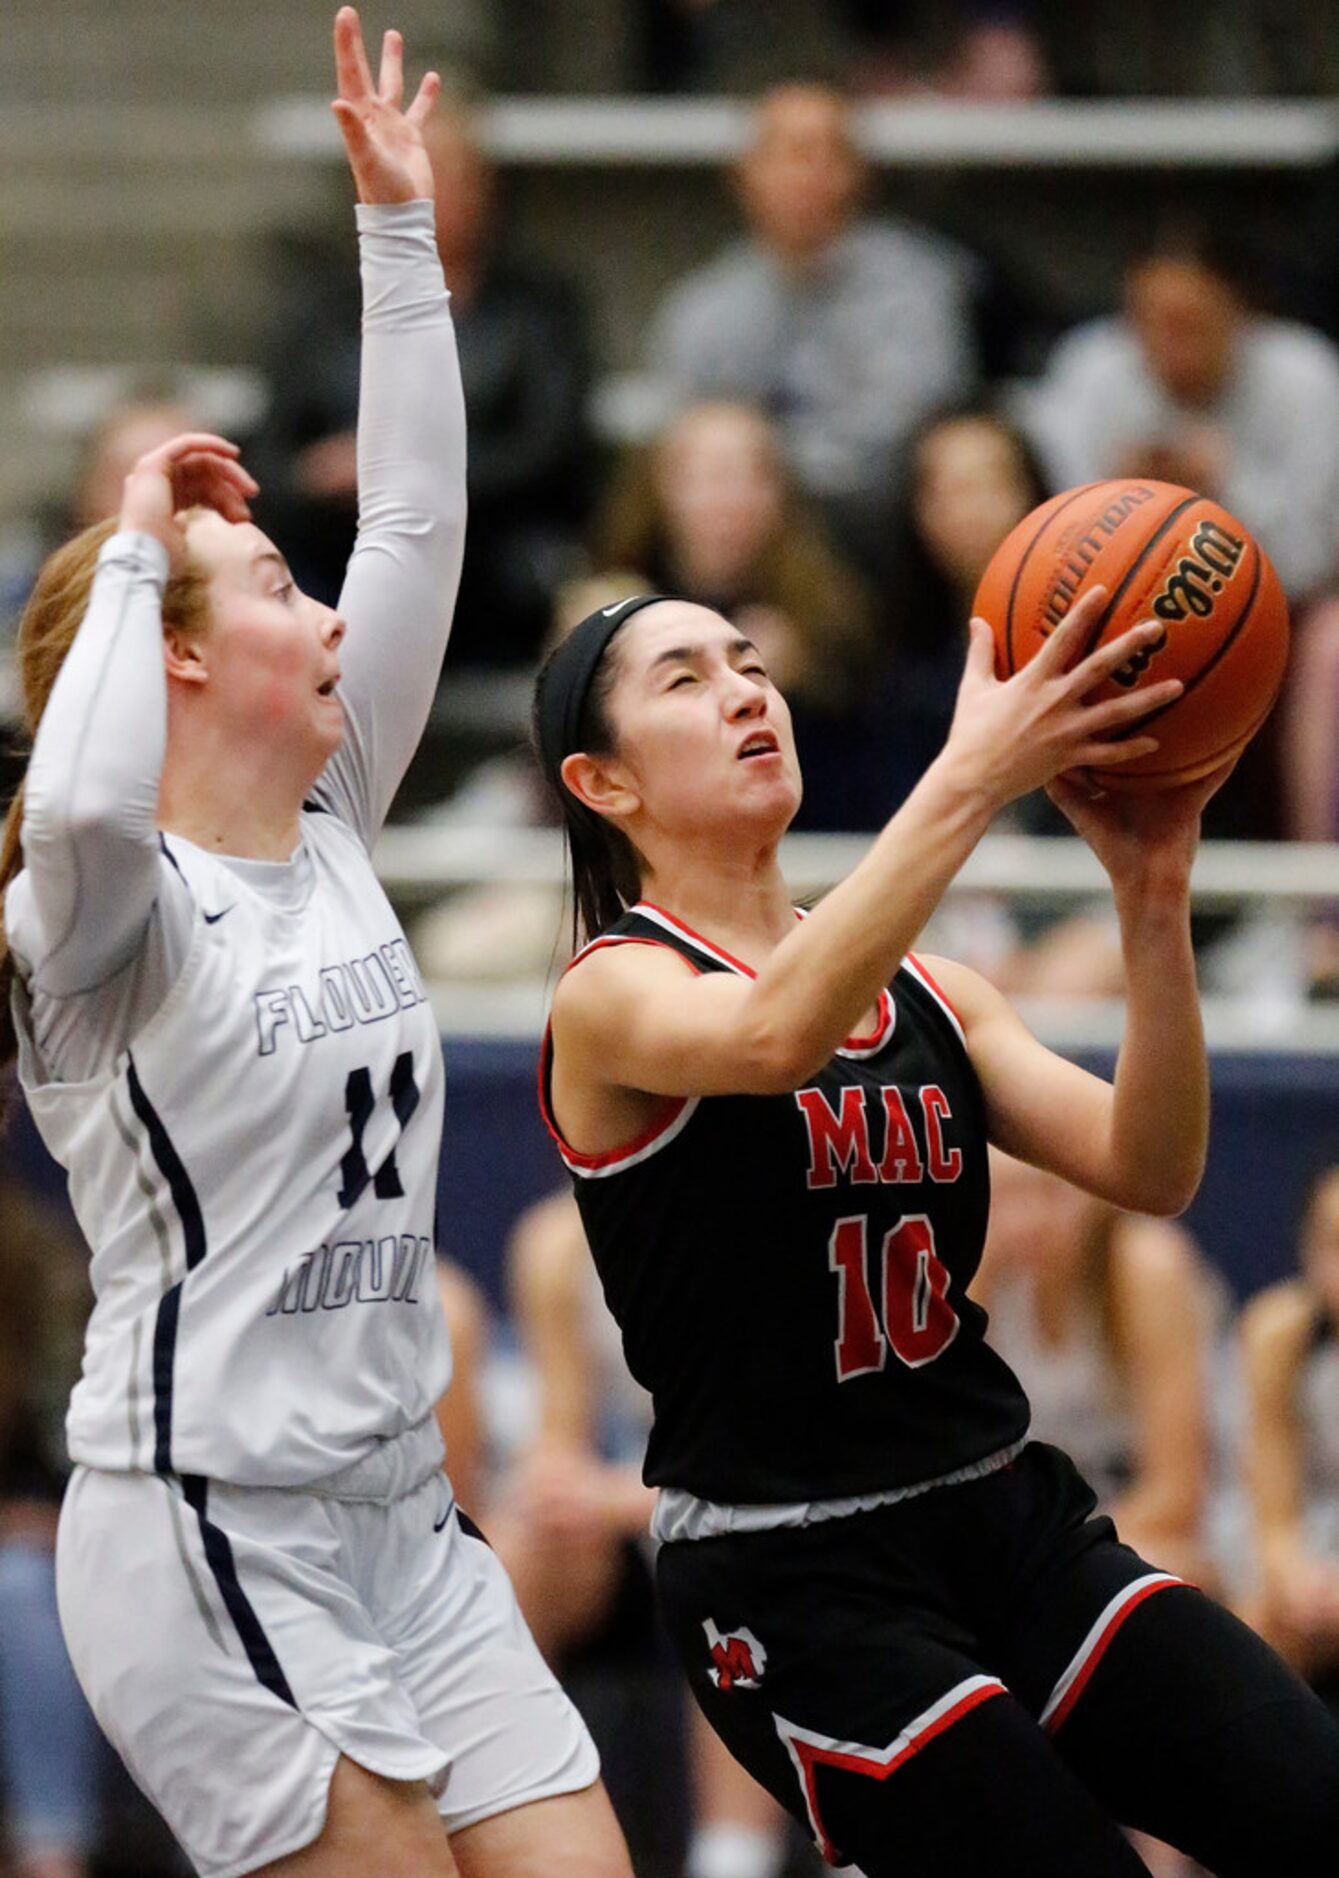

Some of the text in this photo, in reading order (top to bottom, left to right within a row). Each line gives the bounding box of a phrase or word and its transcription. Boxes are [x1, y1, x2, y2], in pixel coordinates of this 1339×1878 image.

[336, 1051, 421, 1210] 11
[794, 1084, 963, 1190] MAC
[265, 1233, 429, 1317] MOUN
[828, 1213, 961, 1384] 10
